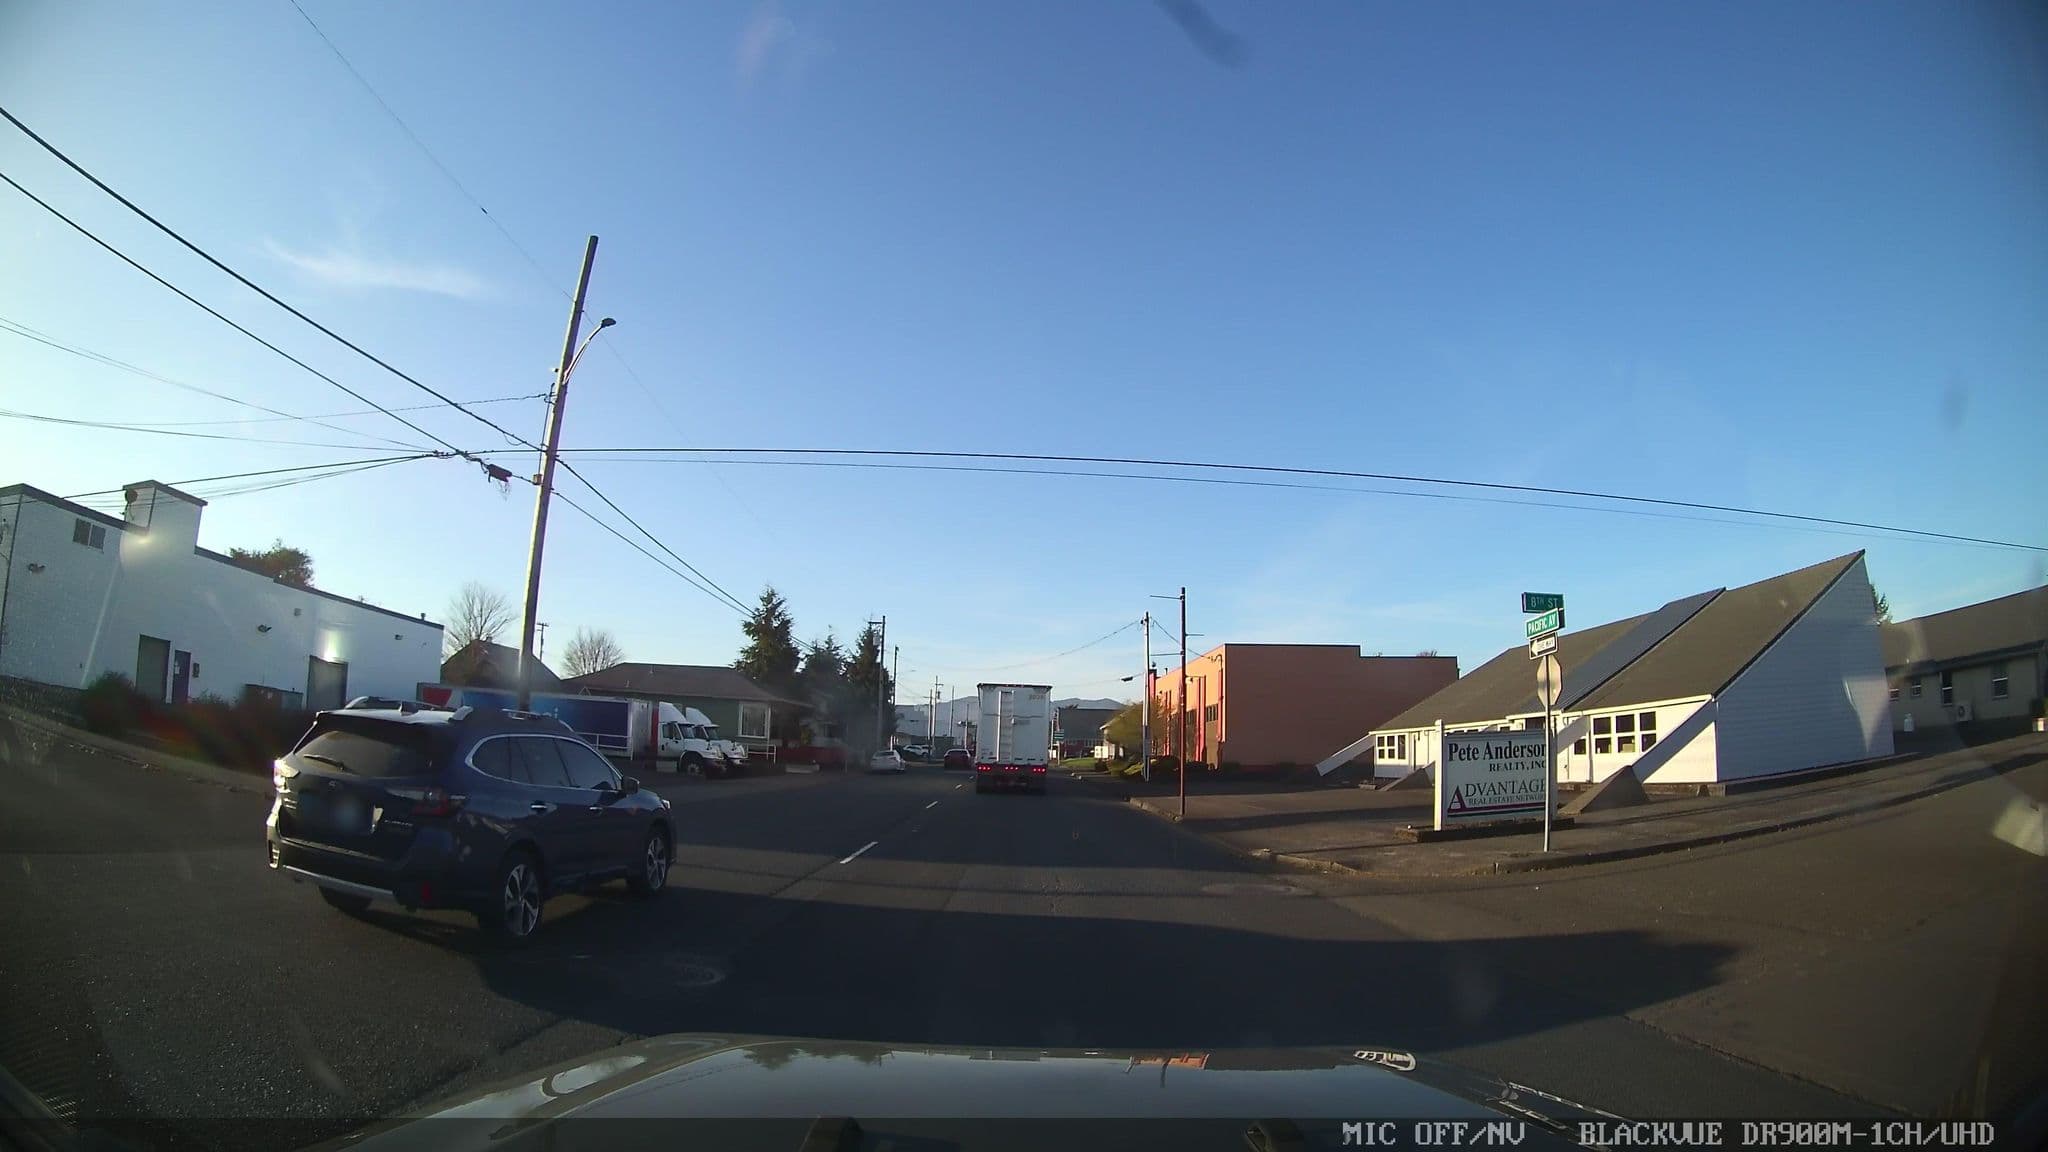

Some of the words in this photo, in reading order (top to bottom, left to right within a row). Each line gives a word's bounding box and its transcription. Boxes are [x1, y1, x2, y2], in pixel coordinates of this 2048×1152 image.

[1530, 596, 1545, 608] 8TH
[1547, 597, 1558, 608] ST
[1527, 617, 1548, 635] PACIFIC
[1448, 742, 1480, 762] Pete
